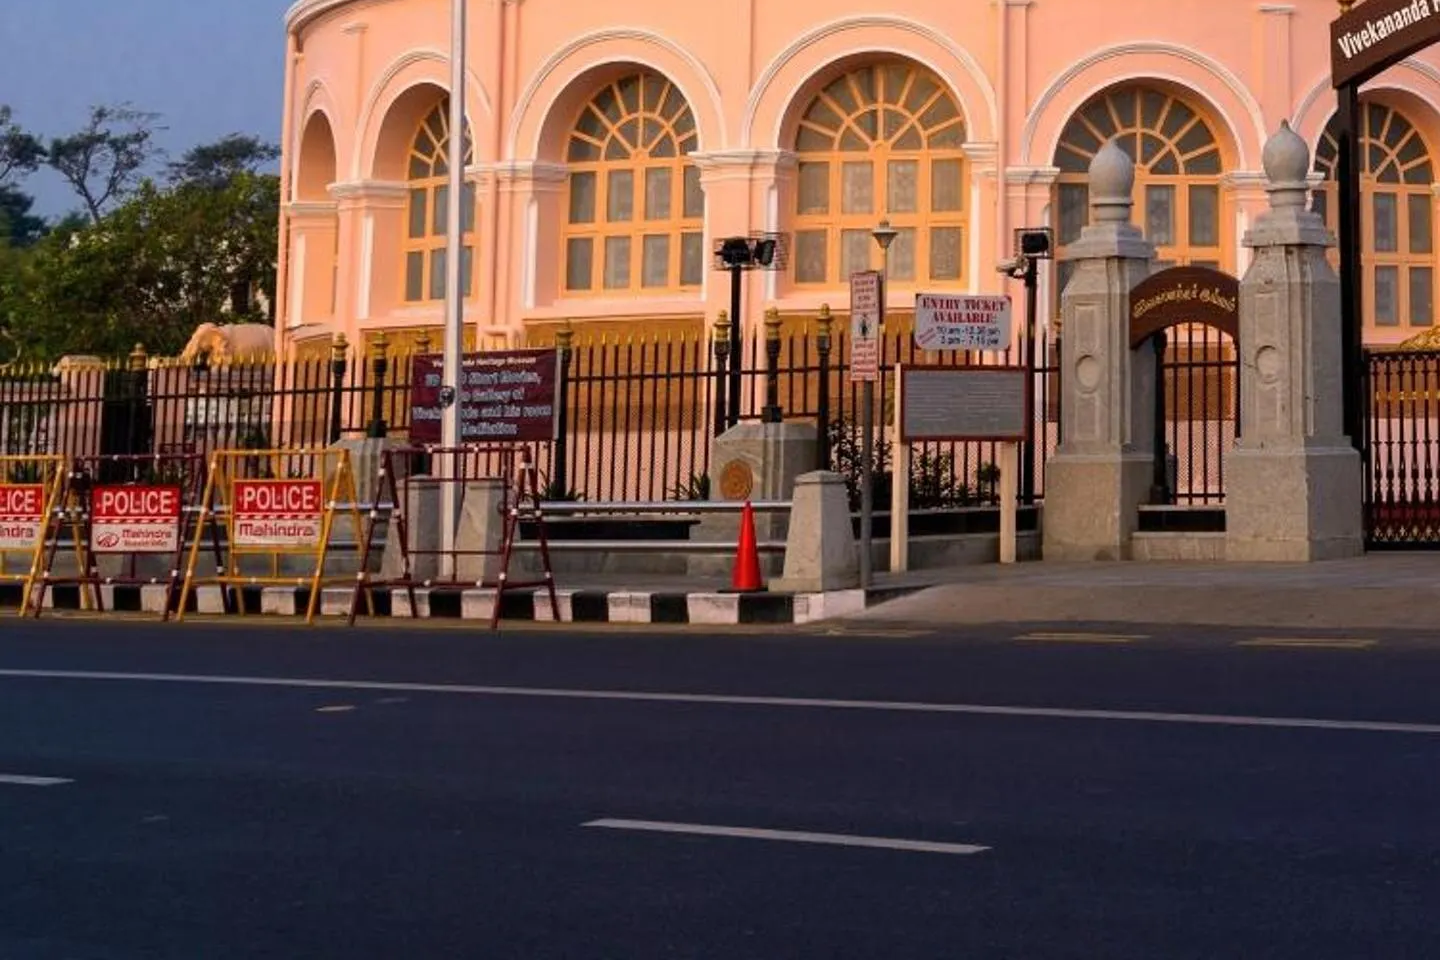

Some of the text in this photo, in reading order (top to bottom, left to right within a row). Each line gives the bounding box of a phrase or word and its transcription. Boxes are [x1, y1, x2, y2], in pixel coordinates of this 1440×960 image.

[922, 297, 1006, 312] ENTRY TICKET
[102, 490, 173, 514] POLICE
[243, 486, 315, 510] POLICE
[122, 528, 172, 539] Mahindra
[240, 523, 316, 537] Mahindra
